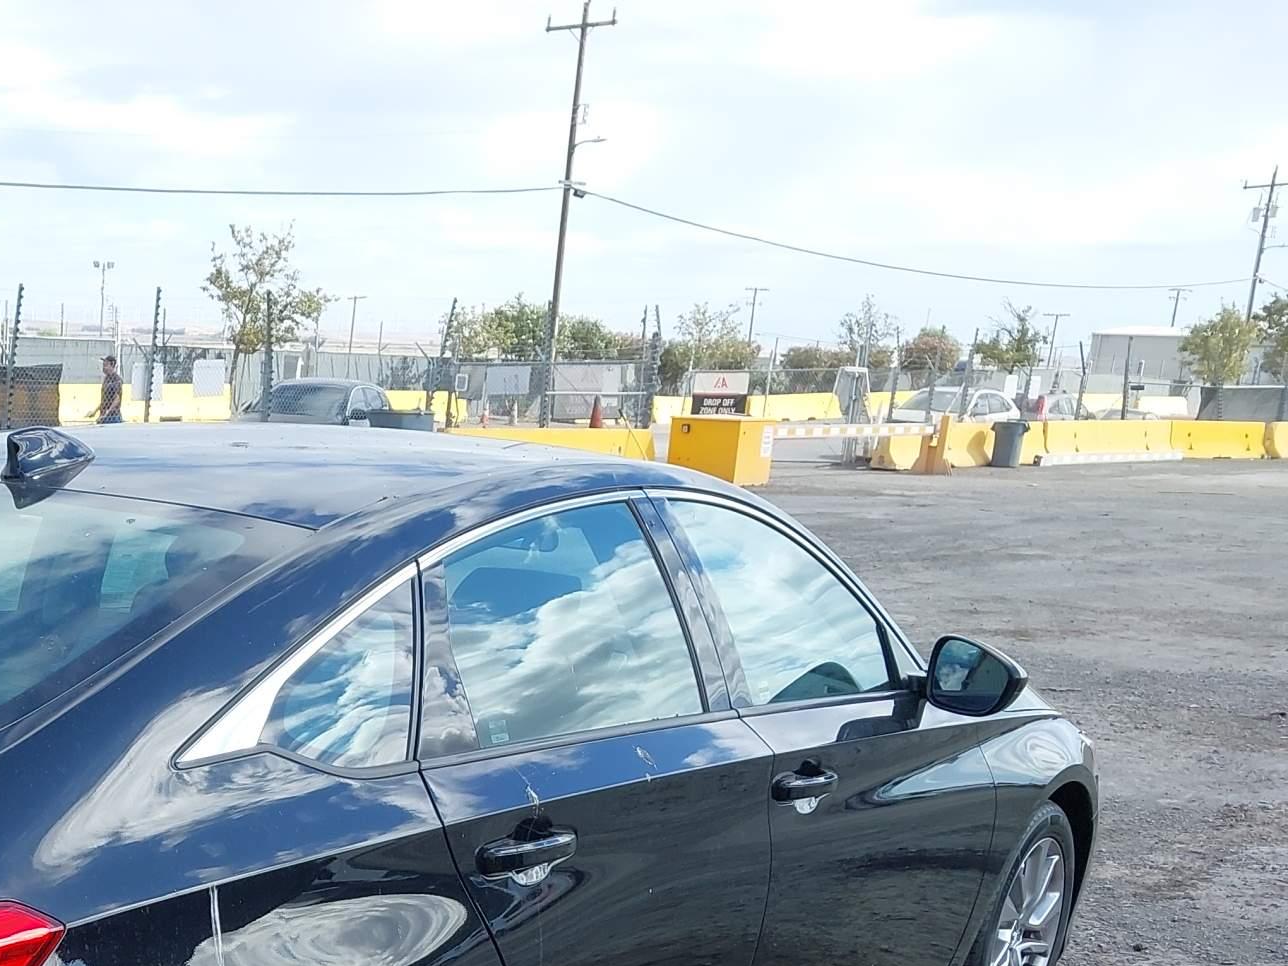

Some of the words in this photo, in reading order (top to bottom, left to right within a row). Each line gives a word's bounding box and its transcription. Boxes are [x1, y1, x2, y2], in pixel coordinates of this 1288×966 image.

[703, 398, 722, 406] DROP
[722, 398, 736, 406] OFF
[717, 406, 736, 414] ONLY
